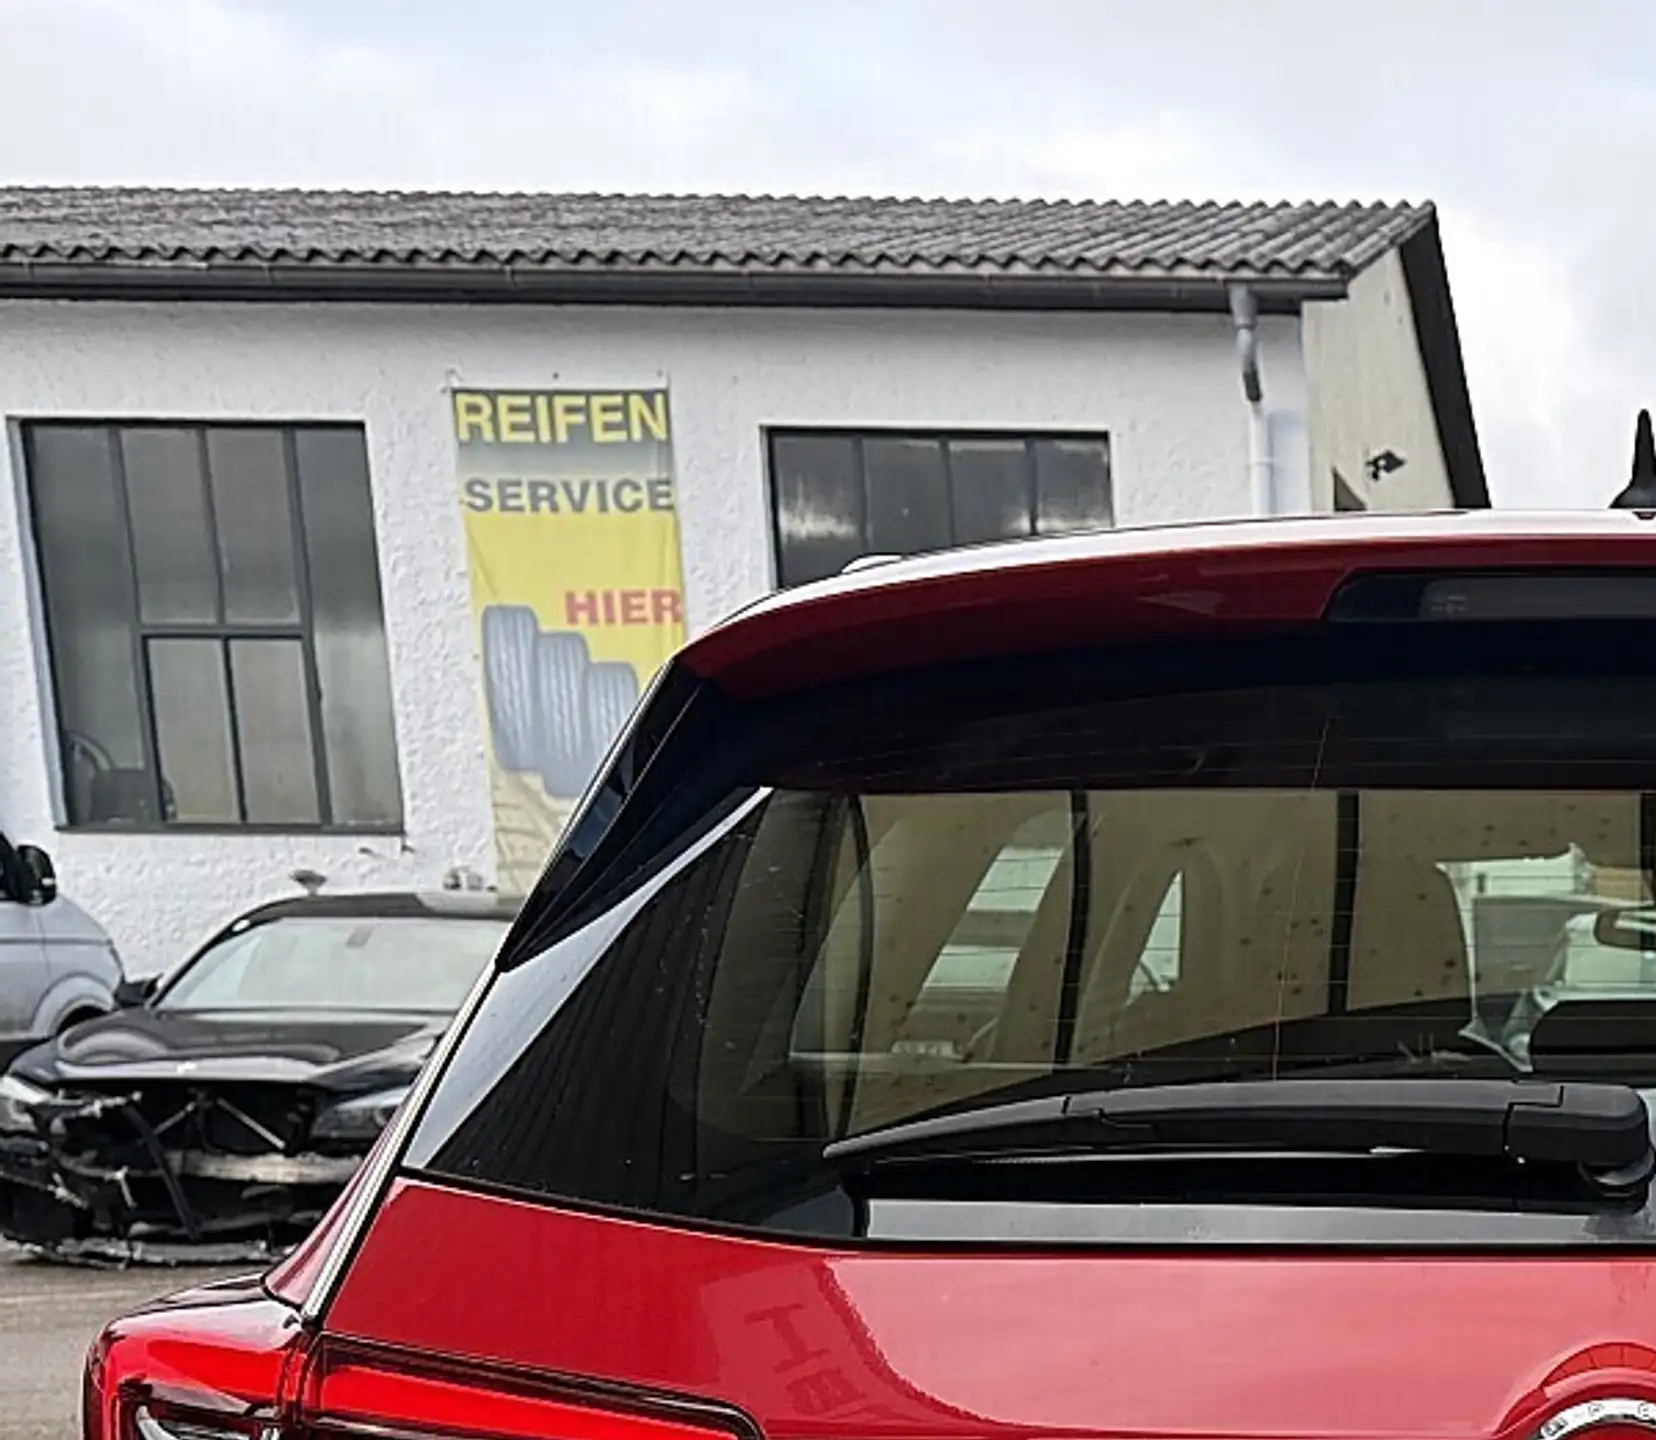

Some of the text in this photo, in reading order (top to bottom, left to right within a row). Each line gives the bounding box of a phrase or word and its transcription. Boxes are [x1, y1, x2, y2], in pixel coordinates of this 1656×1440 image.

[455, 393, 669, 443] REIFEN
[465, 478, 676, 513] SERVICE
[565, 591, 683, 626] HIER
